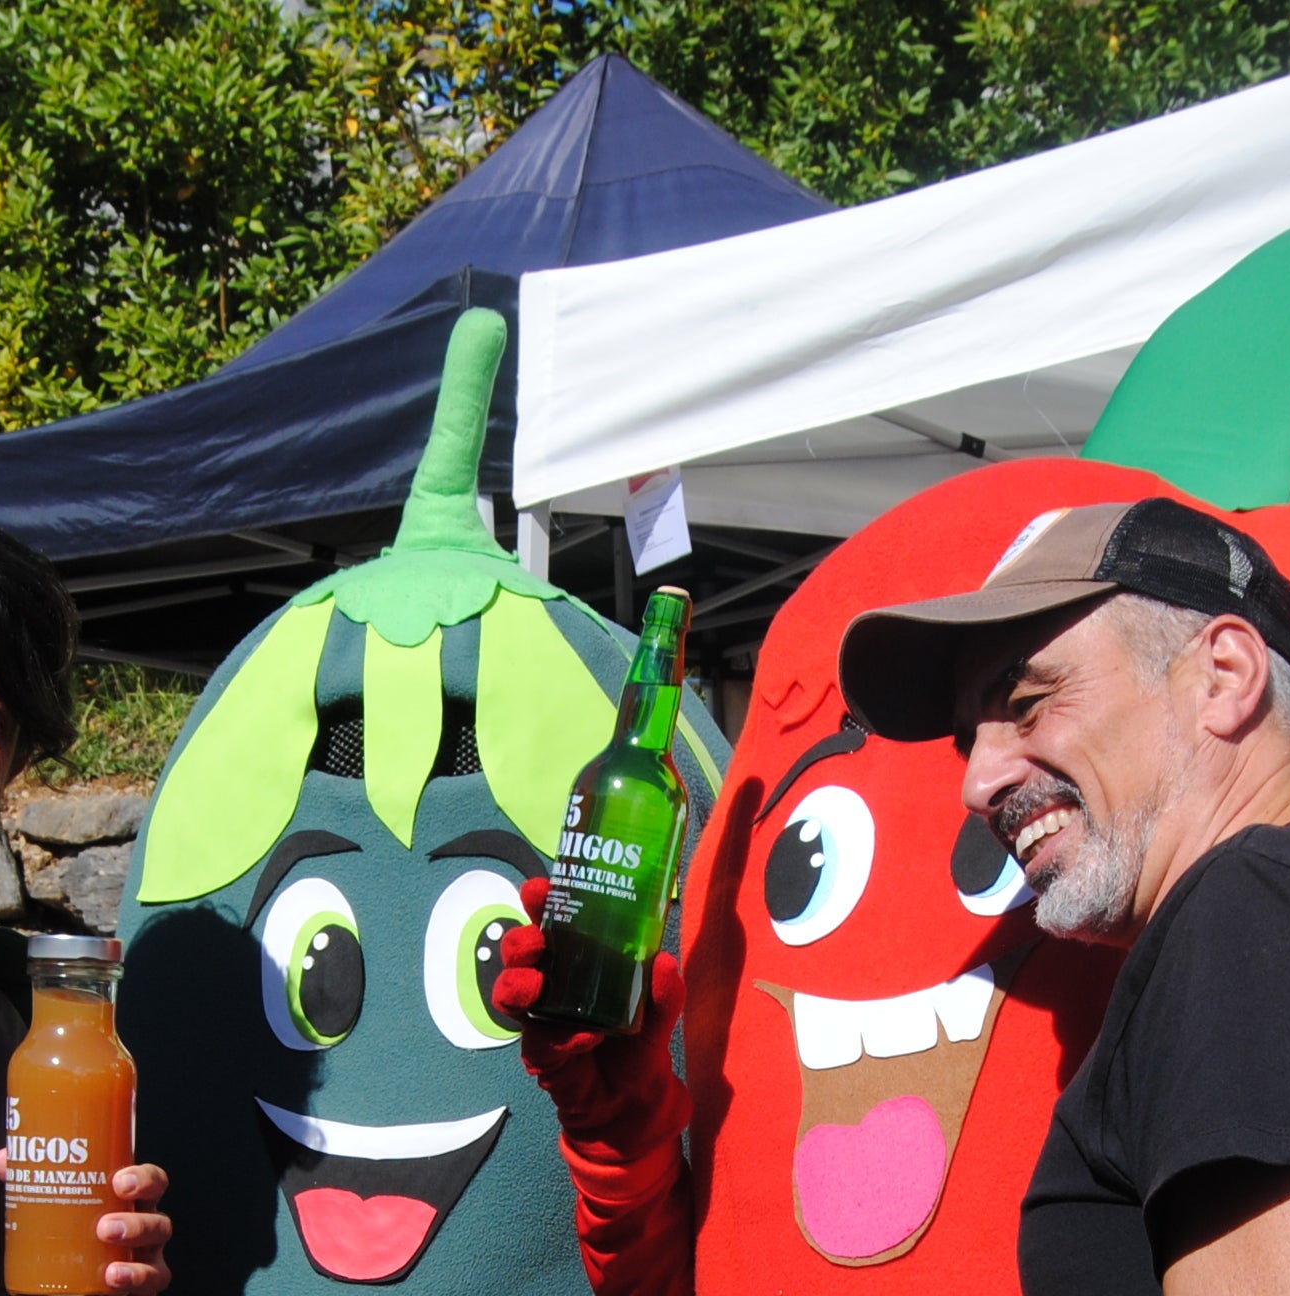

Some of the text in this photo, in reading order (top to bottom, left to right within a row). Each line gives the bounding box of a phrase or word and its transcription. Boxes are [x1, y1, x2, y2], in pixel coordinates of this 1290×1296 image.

[568, 863, 636, 891] NATURAL
[605, 885, 637, 902] PROPIA
[6, 1096, 21, 1131] 5
[15, 1168, 30, 1183] DE
[33, 1170, 107, 1185] MANZANA
[23, 1185, 58, 1195] COSECHA
[59, 1186, 93, 1195] PROPIA
